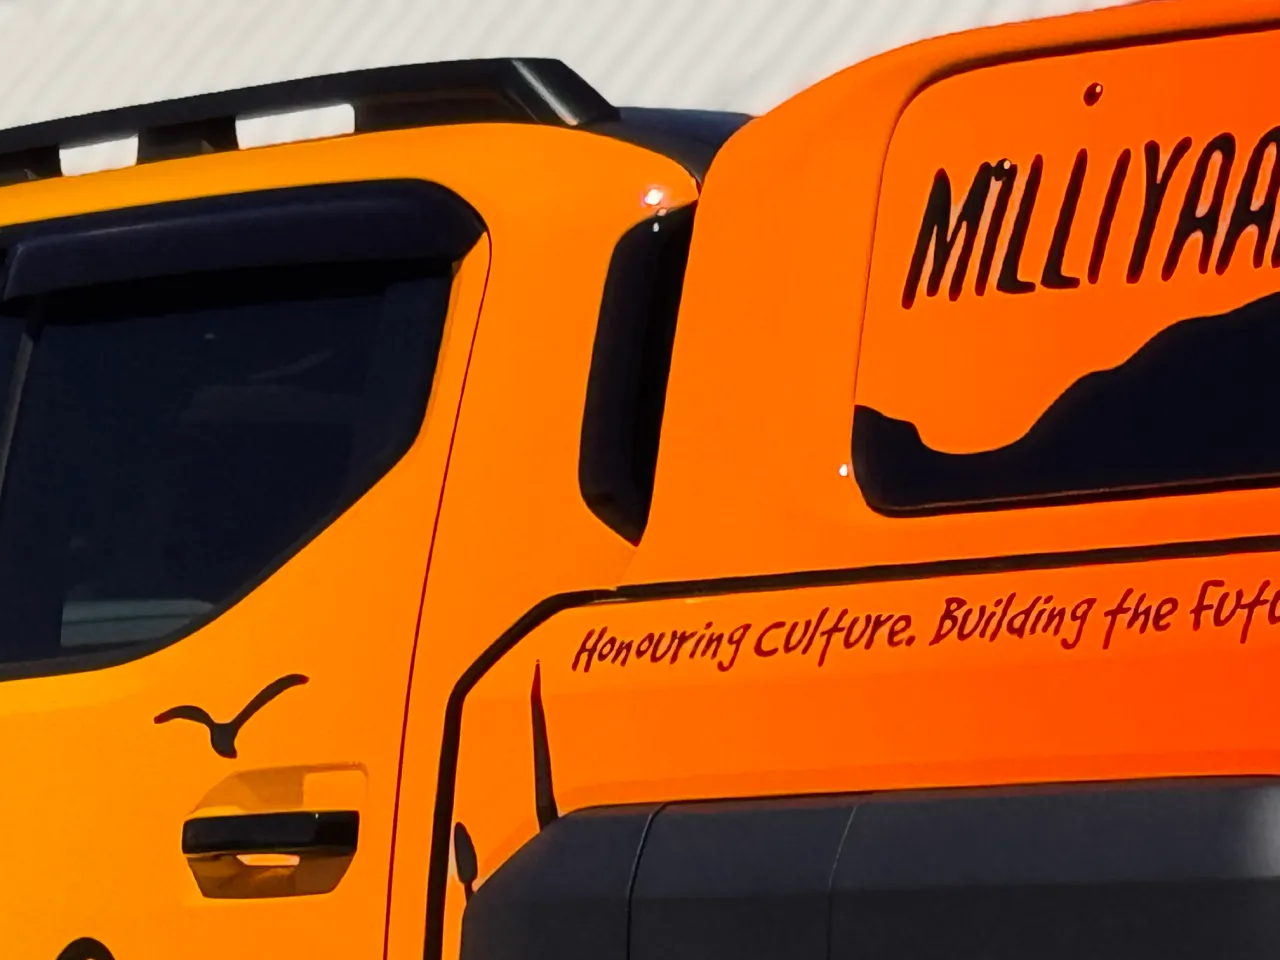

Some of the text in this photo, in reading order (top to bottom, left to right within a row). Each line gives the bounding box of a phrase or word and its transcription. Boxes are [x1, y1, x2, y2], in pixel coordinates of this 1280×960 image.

[901, 125, 1280, 310] MILLIYAA
[571, 621, 753, 674] Honouring
[928, 592, 1098, 650] Building
[1102, 587, 1179, 650] the
